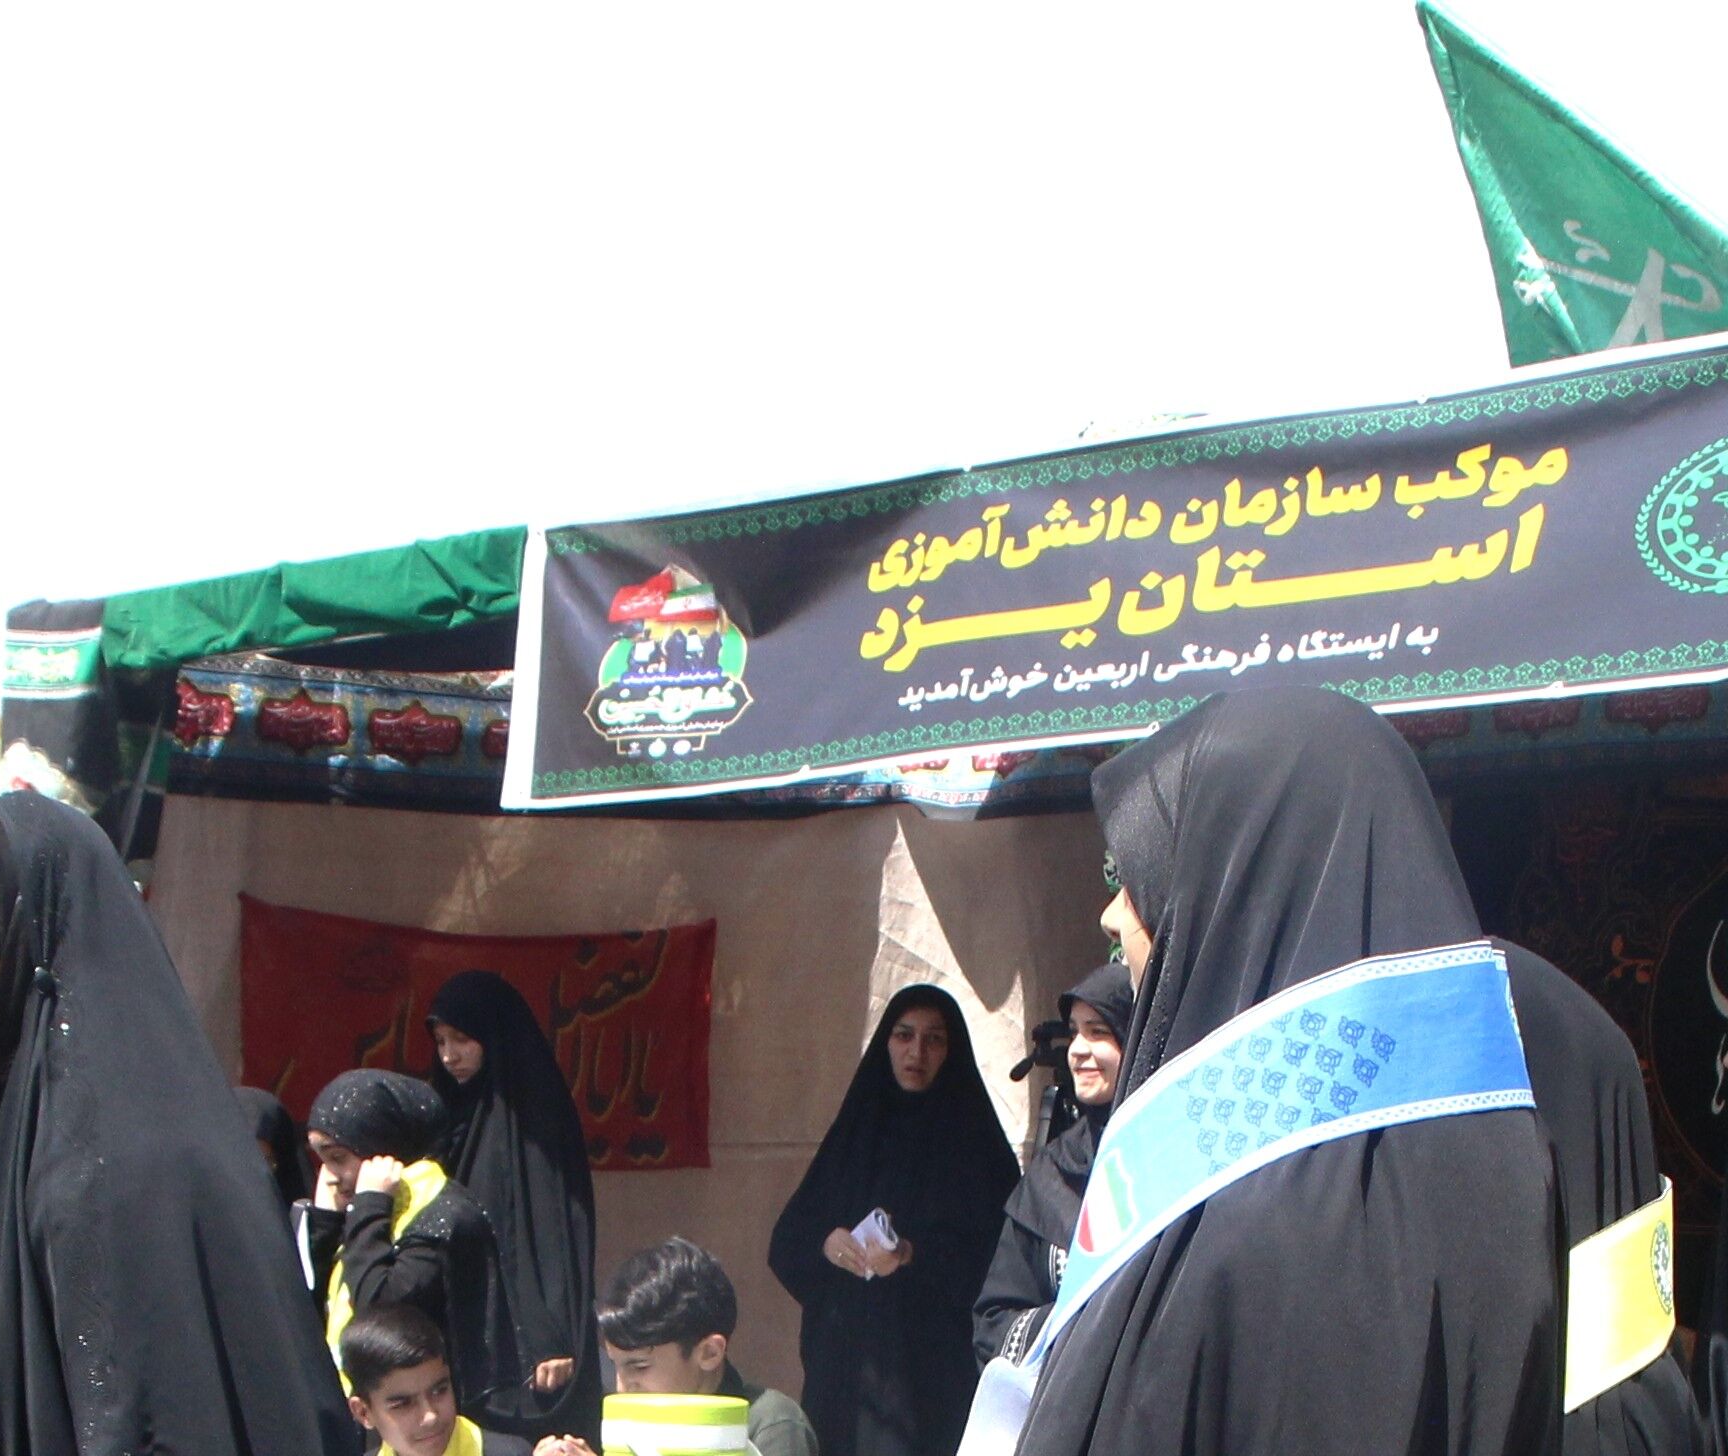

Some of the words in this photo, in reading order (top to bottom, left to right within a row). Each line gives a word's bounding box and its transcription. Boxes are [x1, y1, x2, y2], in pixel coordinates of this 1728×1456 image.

[1392, 443, 1571, 520] موکب
[1170, 467, 1381, 544] سازمان
[1153, 633, 1272, 681] فرهنگی
[1276, 623, 1402, 664] ایستگاه
[1405, 626, 1440, 658] به
[1052, 651, 1149, 693] اربعین
